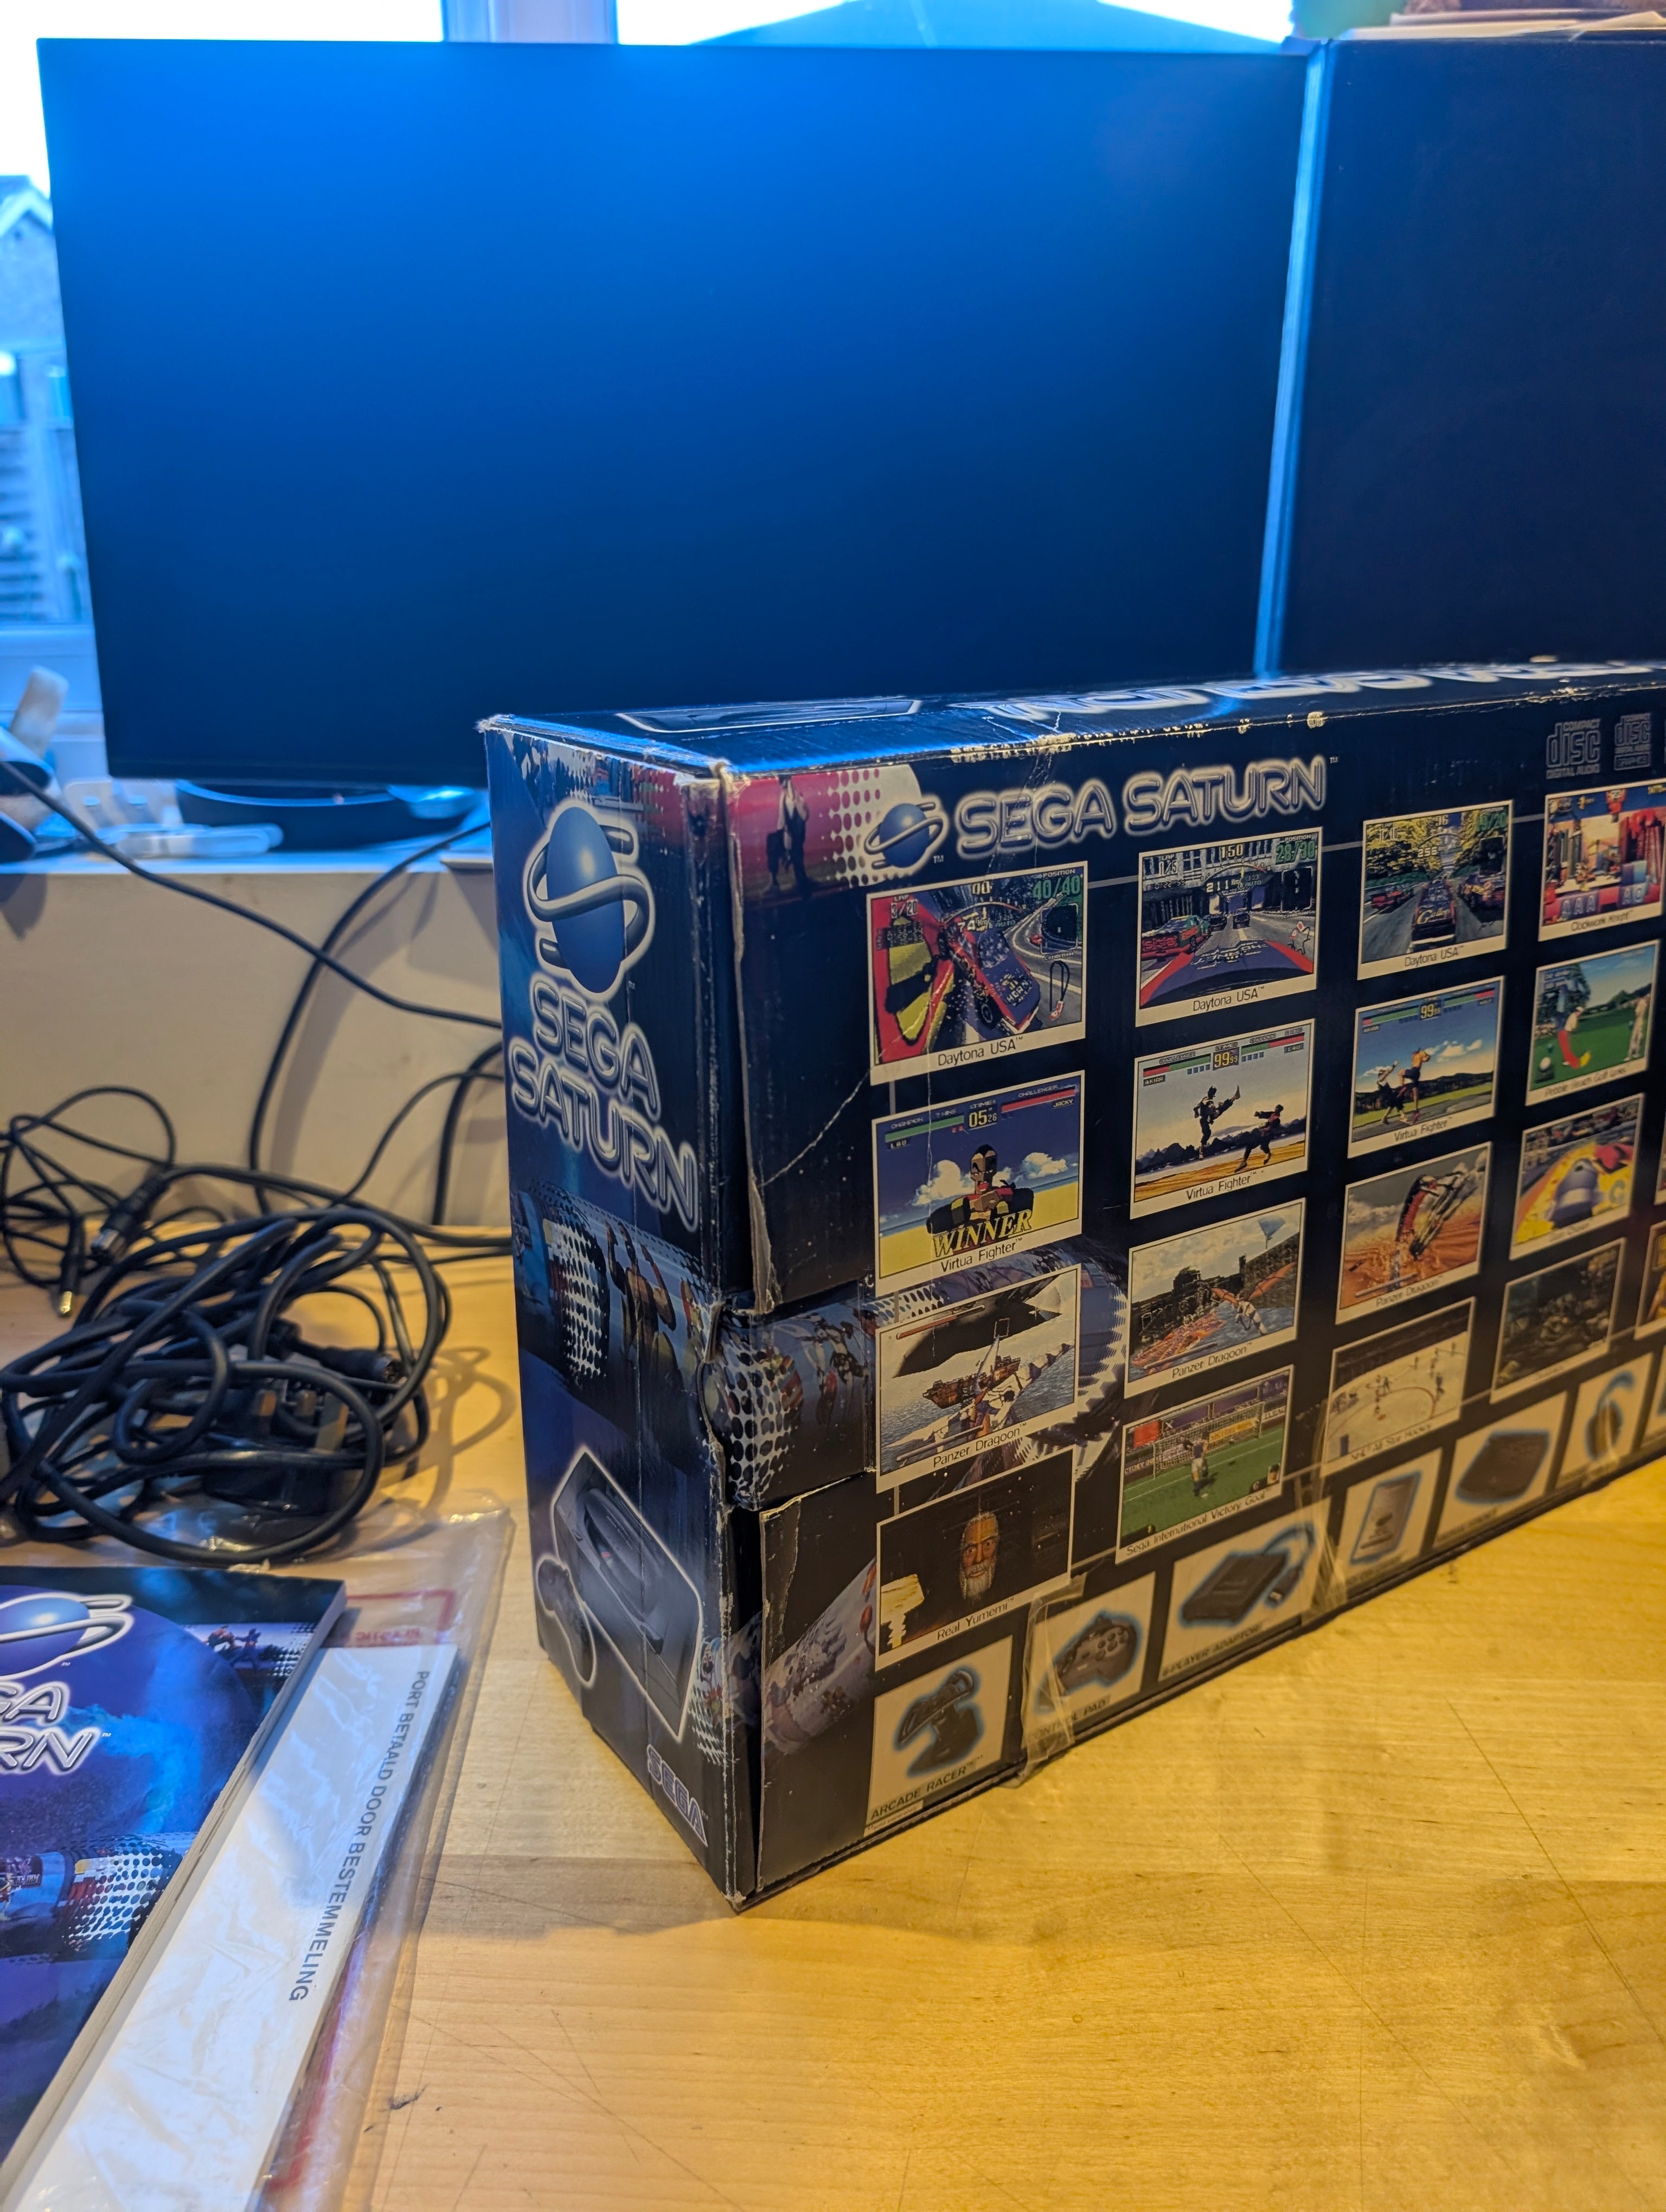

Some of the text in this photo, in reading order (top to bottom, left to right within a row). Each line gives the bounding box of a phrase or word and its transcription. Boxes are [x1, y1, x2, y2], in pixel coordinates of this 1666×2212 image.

[1547, 723, 1600, 768] disc
[956, 779, 1116, 859] SEGA
[1123, 755, 1327, 835] SATURN
[1220, 844, 1244, 859] 150
[1042, 868, 1076, 879] POSITION
[1404, 951, 1437, 968] Daytona
[1193, 994, 1232, 1012] Daytona
[530, 973, 661, 1123] SEGA
[938, 1046, 984, 1067] Daytona
[1144, 1076, 1164, 1085] AKIRA
[1053, 1098, 1074, 1108] JACKY
[509, 1036, 699, 1232] SATURN
[890, 1140, 907, 1149] LAU
[1186, 1185, 1214, 1200] Virtua
[932, 1209, 1033, 1258] WINNER
[940, 1255, 973, 1272] Virtua
[1172, 1360, 1204, 1379] Panzer
[933, 1446, 971, 1468] Panzer
[1126, 1540, 1150, 1557] Sega
[1154, 1513, 1207, 1544] International
[1210, 1501, 1242, 1520] Victory
[937, 1621, 960, 1641] Real
[405, 1670, 431, 1709] PORT
[377, 1713, 415, 1780] BETAALD
[646, 1744, 708, 1848] SEGA
[870, 1786, 921, 1821] ARCADE
[354, 1785, 387, 1837] DOOR
[288, 1842, 366, 2002] BESTEMMELING
